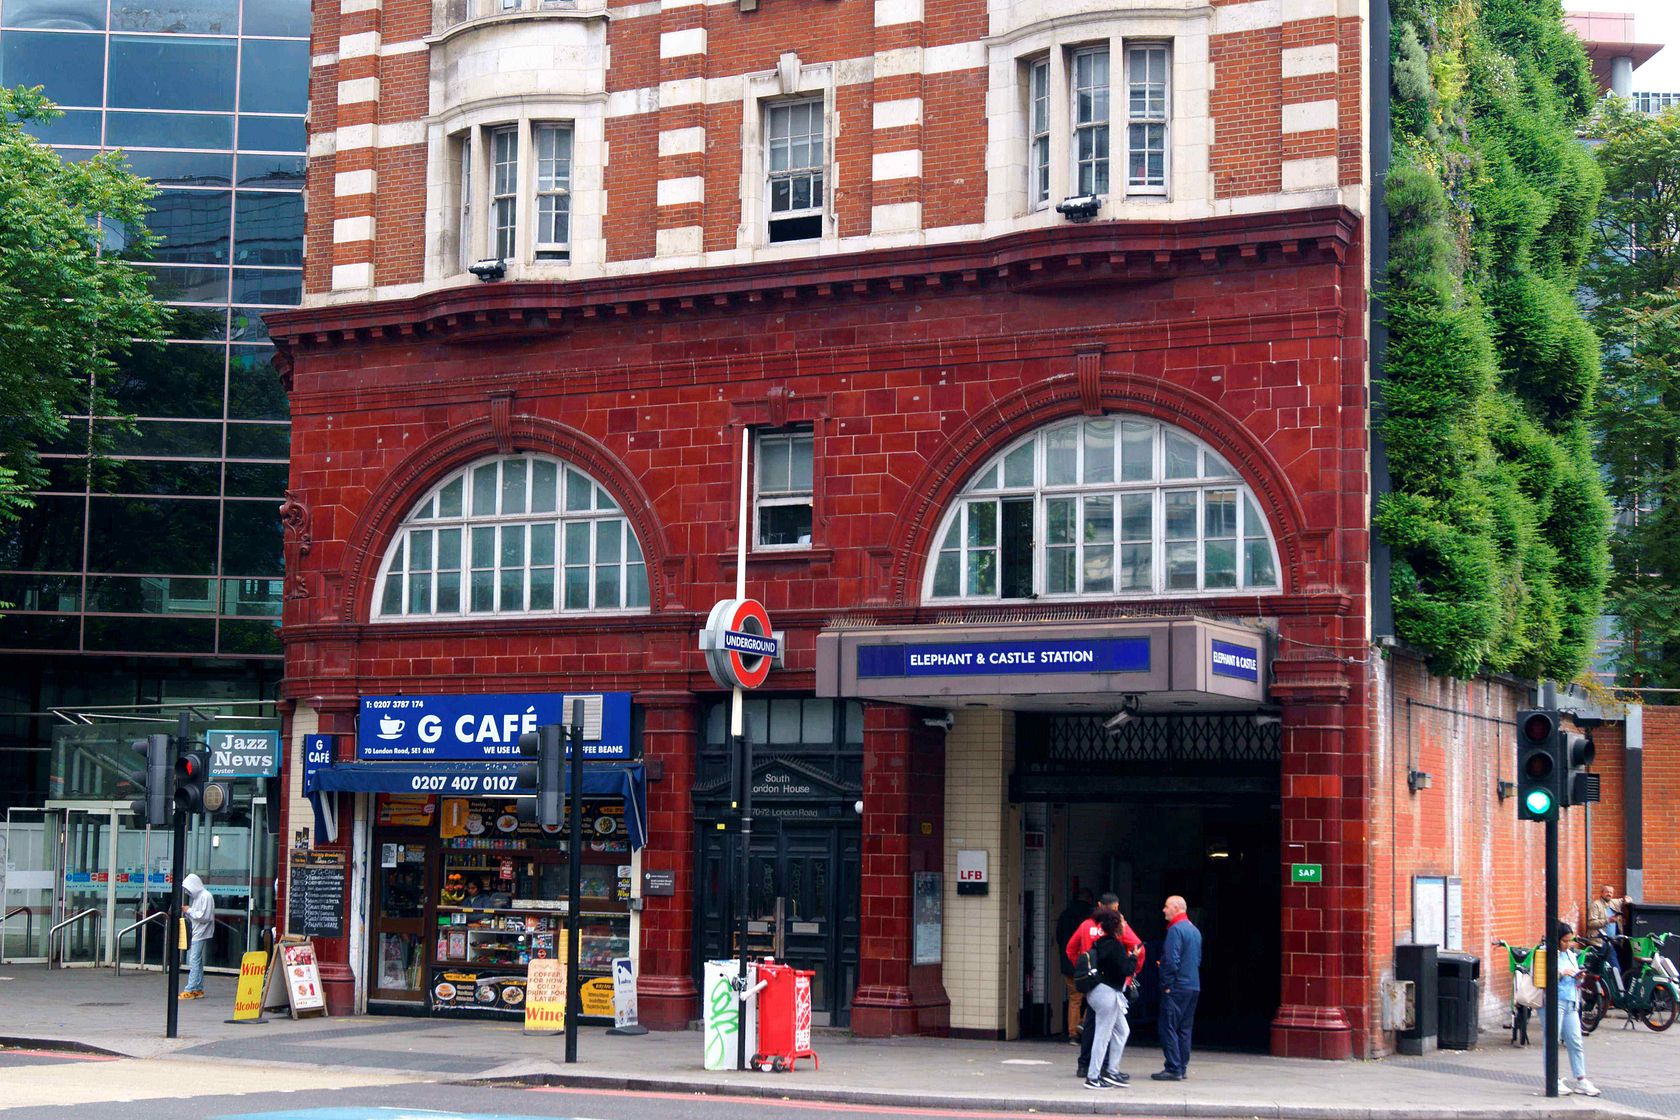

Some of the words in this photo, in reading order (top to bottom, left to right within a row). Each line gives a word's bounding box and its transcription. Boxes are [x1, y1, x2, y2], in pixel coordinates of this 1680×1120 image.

[726, 634, 776, 653] UNDERGROUND
[910, 653, 972, 666] ELEPHANT
[976, 653, 985, 665] &
[989, 651, 1035, 664] CASTLE
[1040, 650, 1093, 663] STATION
[1213, 651, 1235, 666] ELEPHANT
[1236, 656, 1240, 667] &
[1241, 657, 1256, 670] CASTLE
[365, 700, 372, 708] T:
[373, 700, 391, 708] 0207
[392, 700, 410, 708] 3787
[411, 700, 424, 708] 174
[418, 714, 442, 743] G
[455, 705, 537, 743] CAFÉ
[221, 734, 267, 750] Jazz
[316, 740, 323, 750] G
[394, 747, 410, 755] Road,
[483, 746, 495, 754] WE
[496, 746, 510, 754] USE
[598, 745, 623, 754] BEANS
[214, 751, 272, 767] News
[308, 750, 330, 763] CAFÉ
[411, 776, 447, 790] 0207
[451, 776, 478, 790] 407
[482, 776, 518, 790] 0107
[765, 773, 790, 783] South
[751, 784, 779, 793] ondon
[783, 784, 810, 793] House
[772, 808, 798, 817] London
[799, 808, 817, 817] Road
[960, 870, 983, 880] LFB
[1298, 869, 1316, 877] SAP
[241, 962, 267, 976] Wine
[247, 987, 252, 995] &
[526, 1007, 563, 1021] Wine
